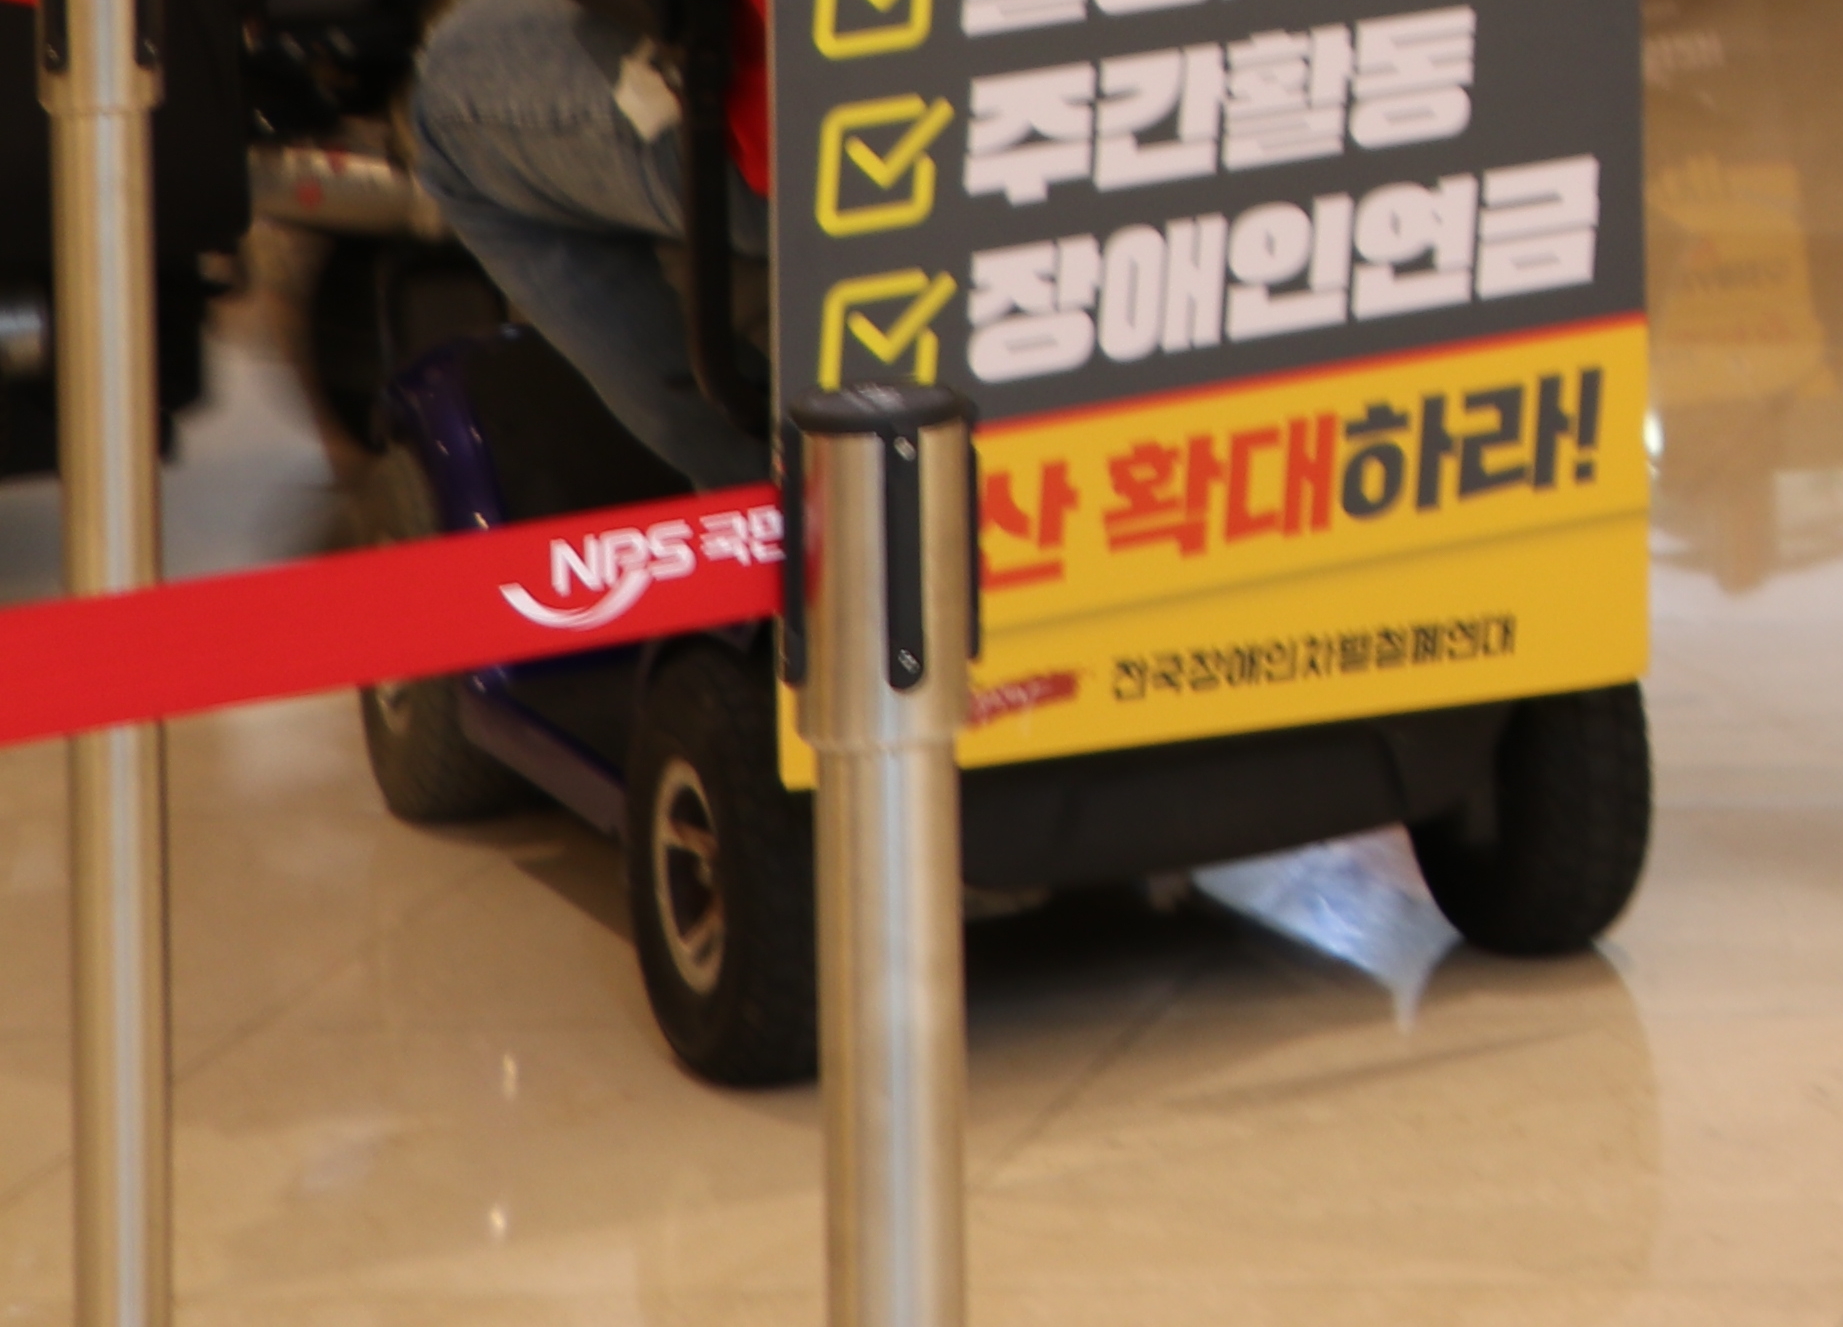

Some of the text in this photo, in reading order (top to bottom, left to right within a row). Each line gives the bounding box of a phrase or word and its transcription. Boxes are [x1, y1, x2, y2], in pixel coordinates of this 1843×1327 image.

[963, 6, 1478, 207] 주간활동
[965, 153, 1602, 387] 장애인연금
[549, 517, 699, 598] NPS
[976, 367, 1602, 595] 산 확대하라!
